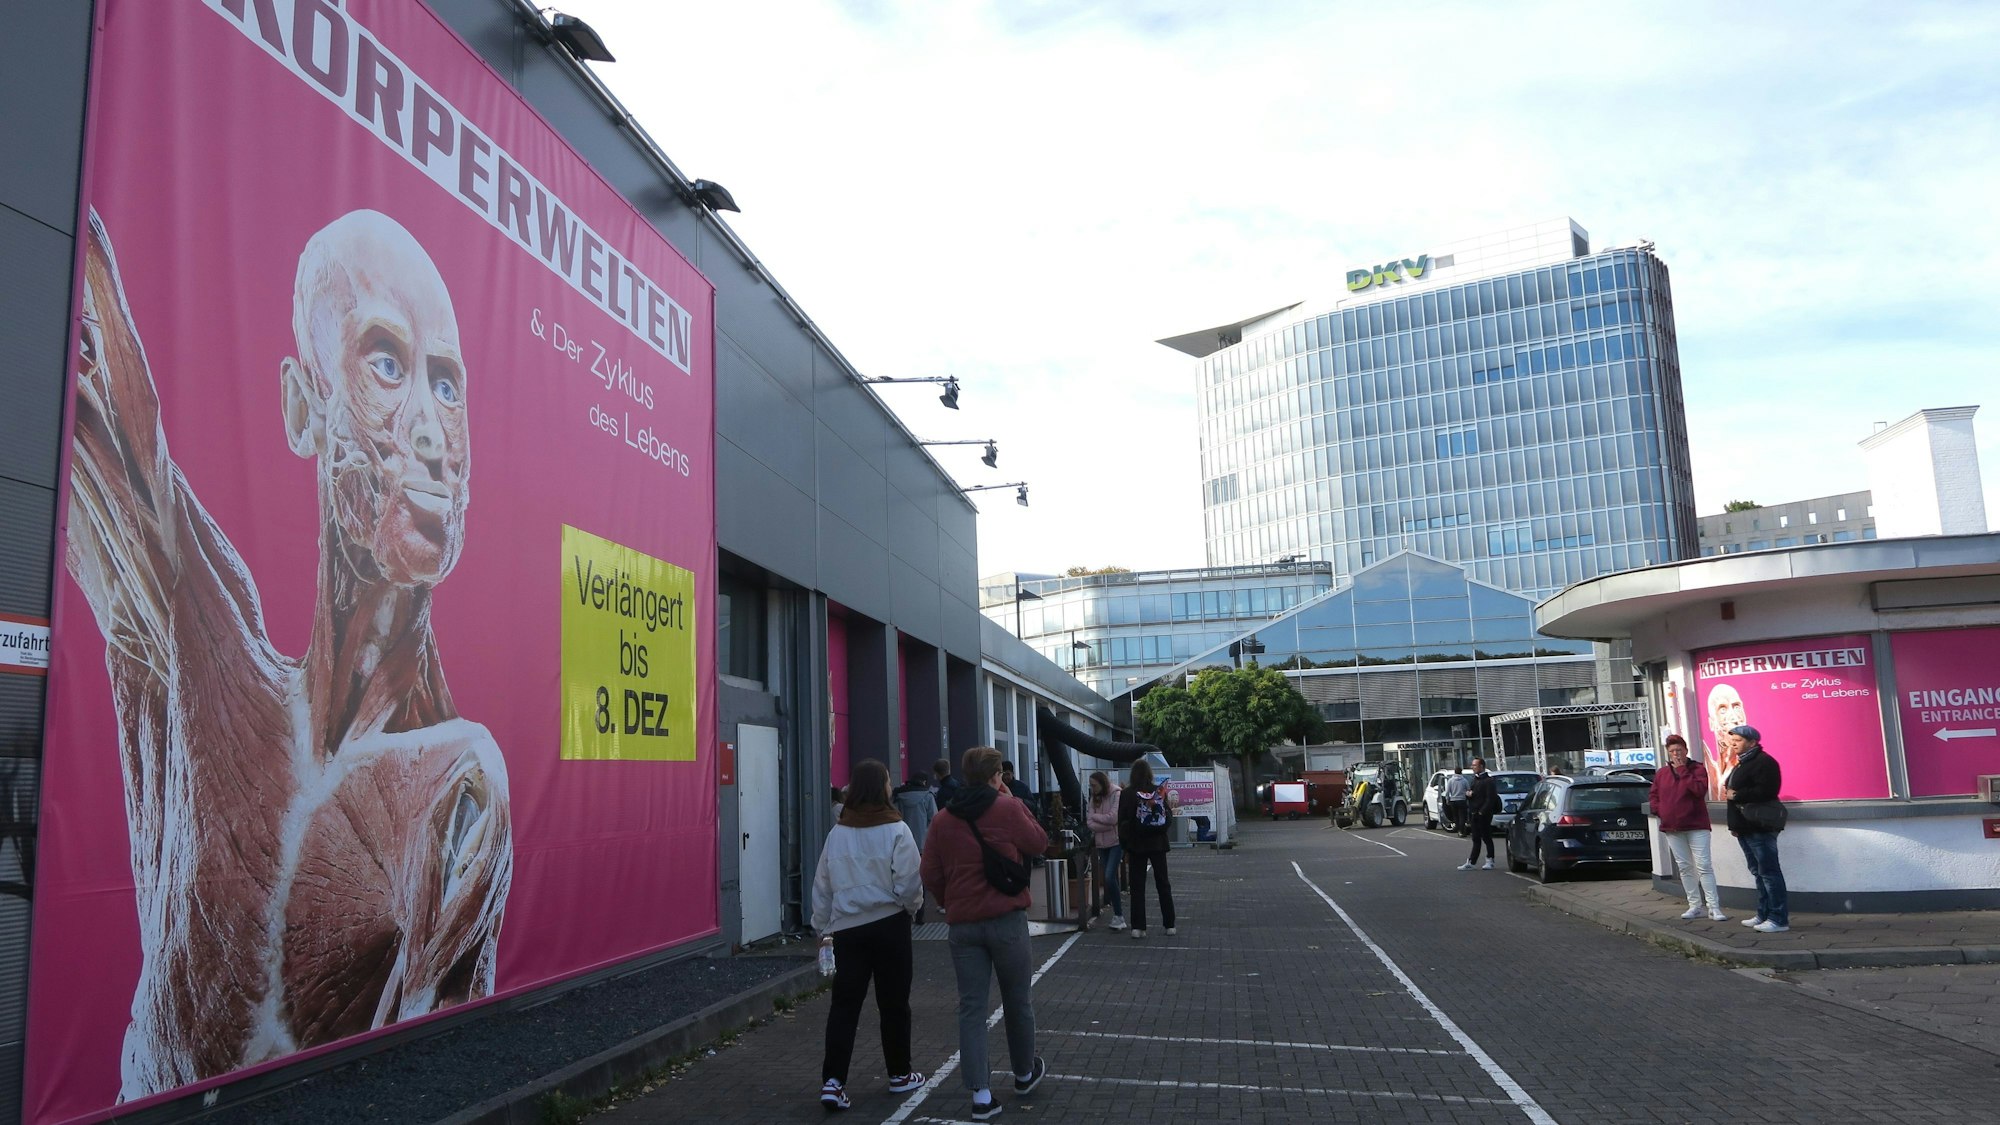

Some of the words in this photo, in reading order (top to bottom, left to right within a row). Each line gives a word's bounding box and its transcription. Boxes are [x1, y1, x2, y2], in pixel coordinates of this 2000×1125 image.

[1346, 254, 1428, 291] DKV
[530, 308, 546, 341] &
[553, 322, 583, 363] Der
[591, 339, 653, 410] Zyklus
[589, 404, 619, 437] des
[625, 412, 689, 477] Lebens
[575, 554, 683, 632] Verlängert
[620, 629, 649, 678] bis
[1700, 650, 1864, 677] KÖRPERWELTEN
[1801, 677, 1842, 689] Zyklus
[1801, 692, 1819, 700] des
[1822, 688, 1870, 699] Lebens
[595, 686, 616, 734] 8.
[624, 689, 669, 737] DEZ
[1921, 707, 2000, 723] ENTRANCE
